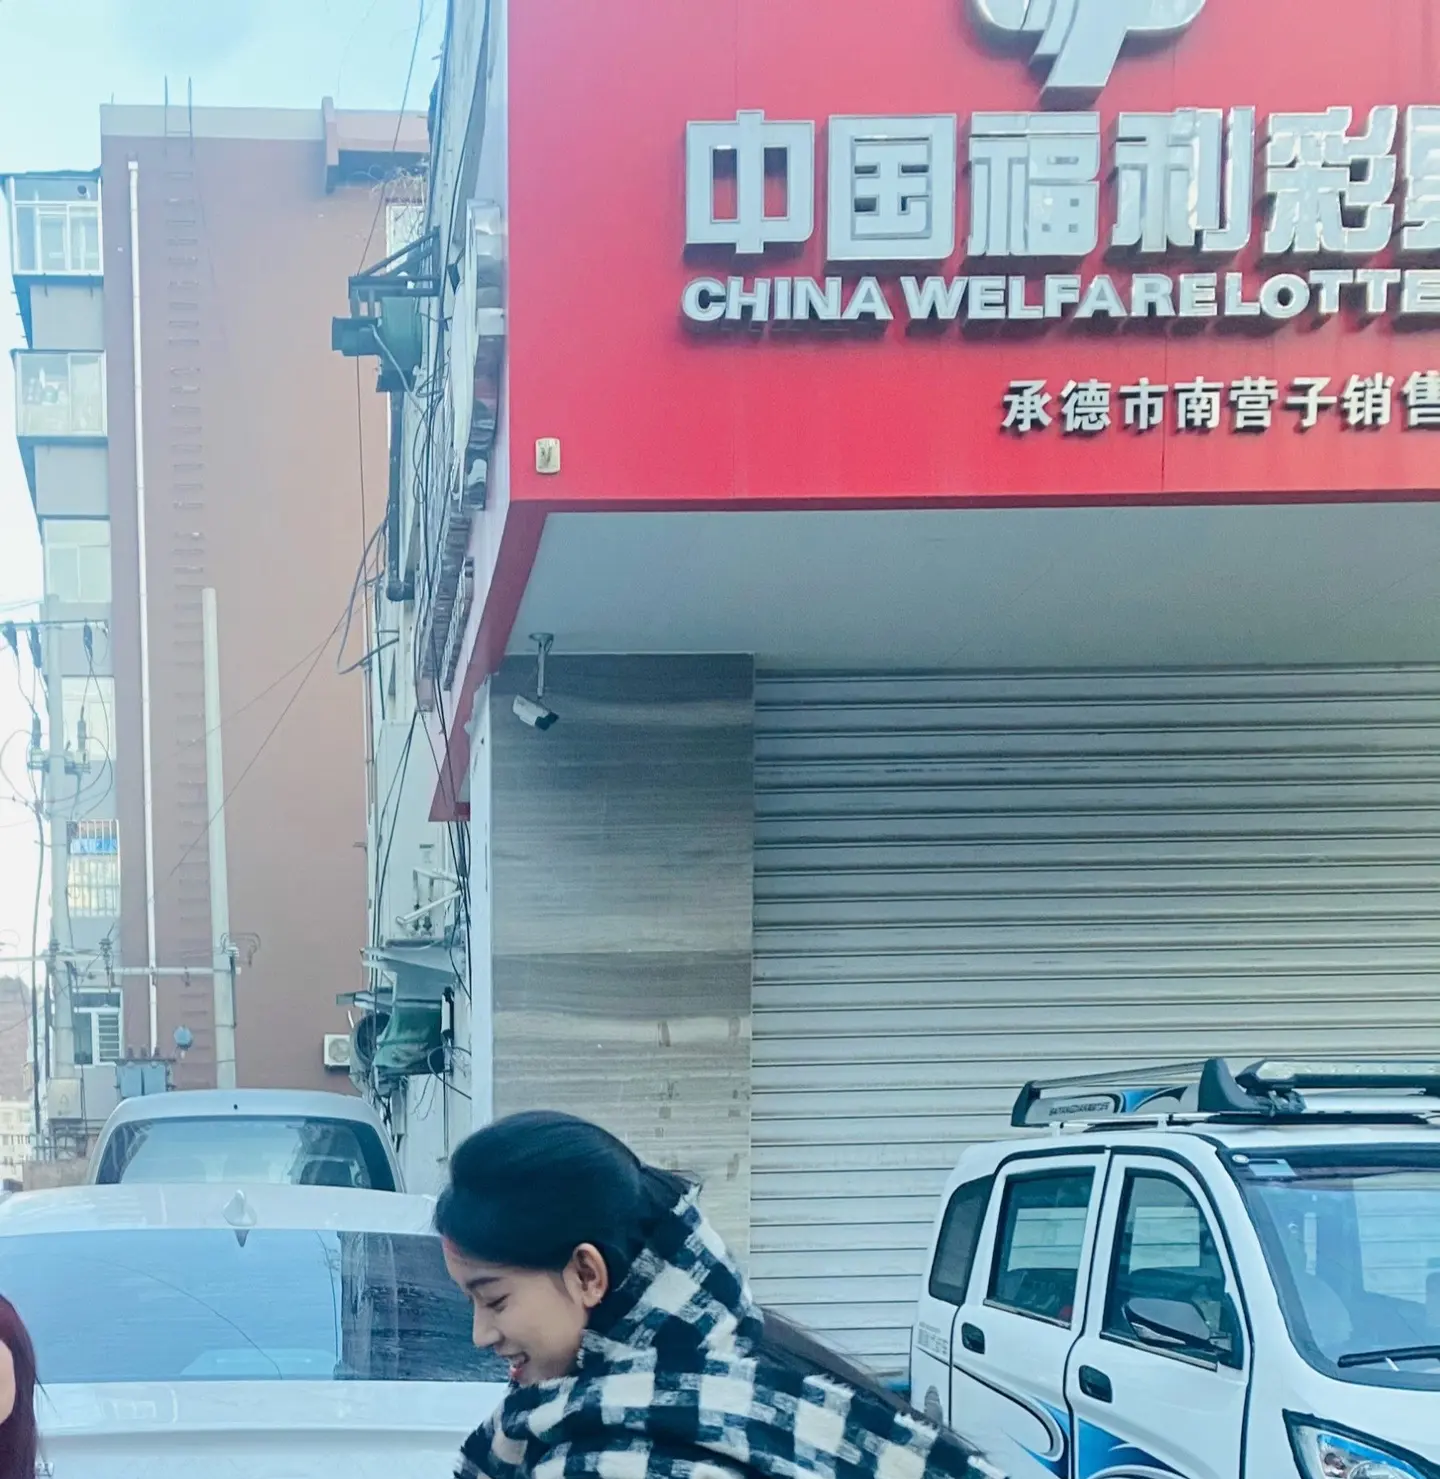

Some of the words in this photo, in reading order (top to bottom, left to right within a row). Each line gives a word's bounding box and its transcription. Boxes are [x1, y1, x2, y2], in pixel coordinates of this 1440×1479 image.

[685, 106, 1440, 260] 中国福利彩
[682, 276, 893, 322] CHINA
[1002, 371, 1440, 432] 承德市南营子销售
